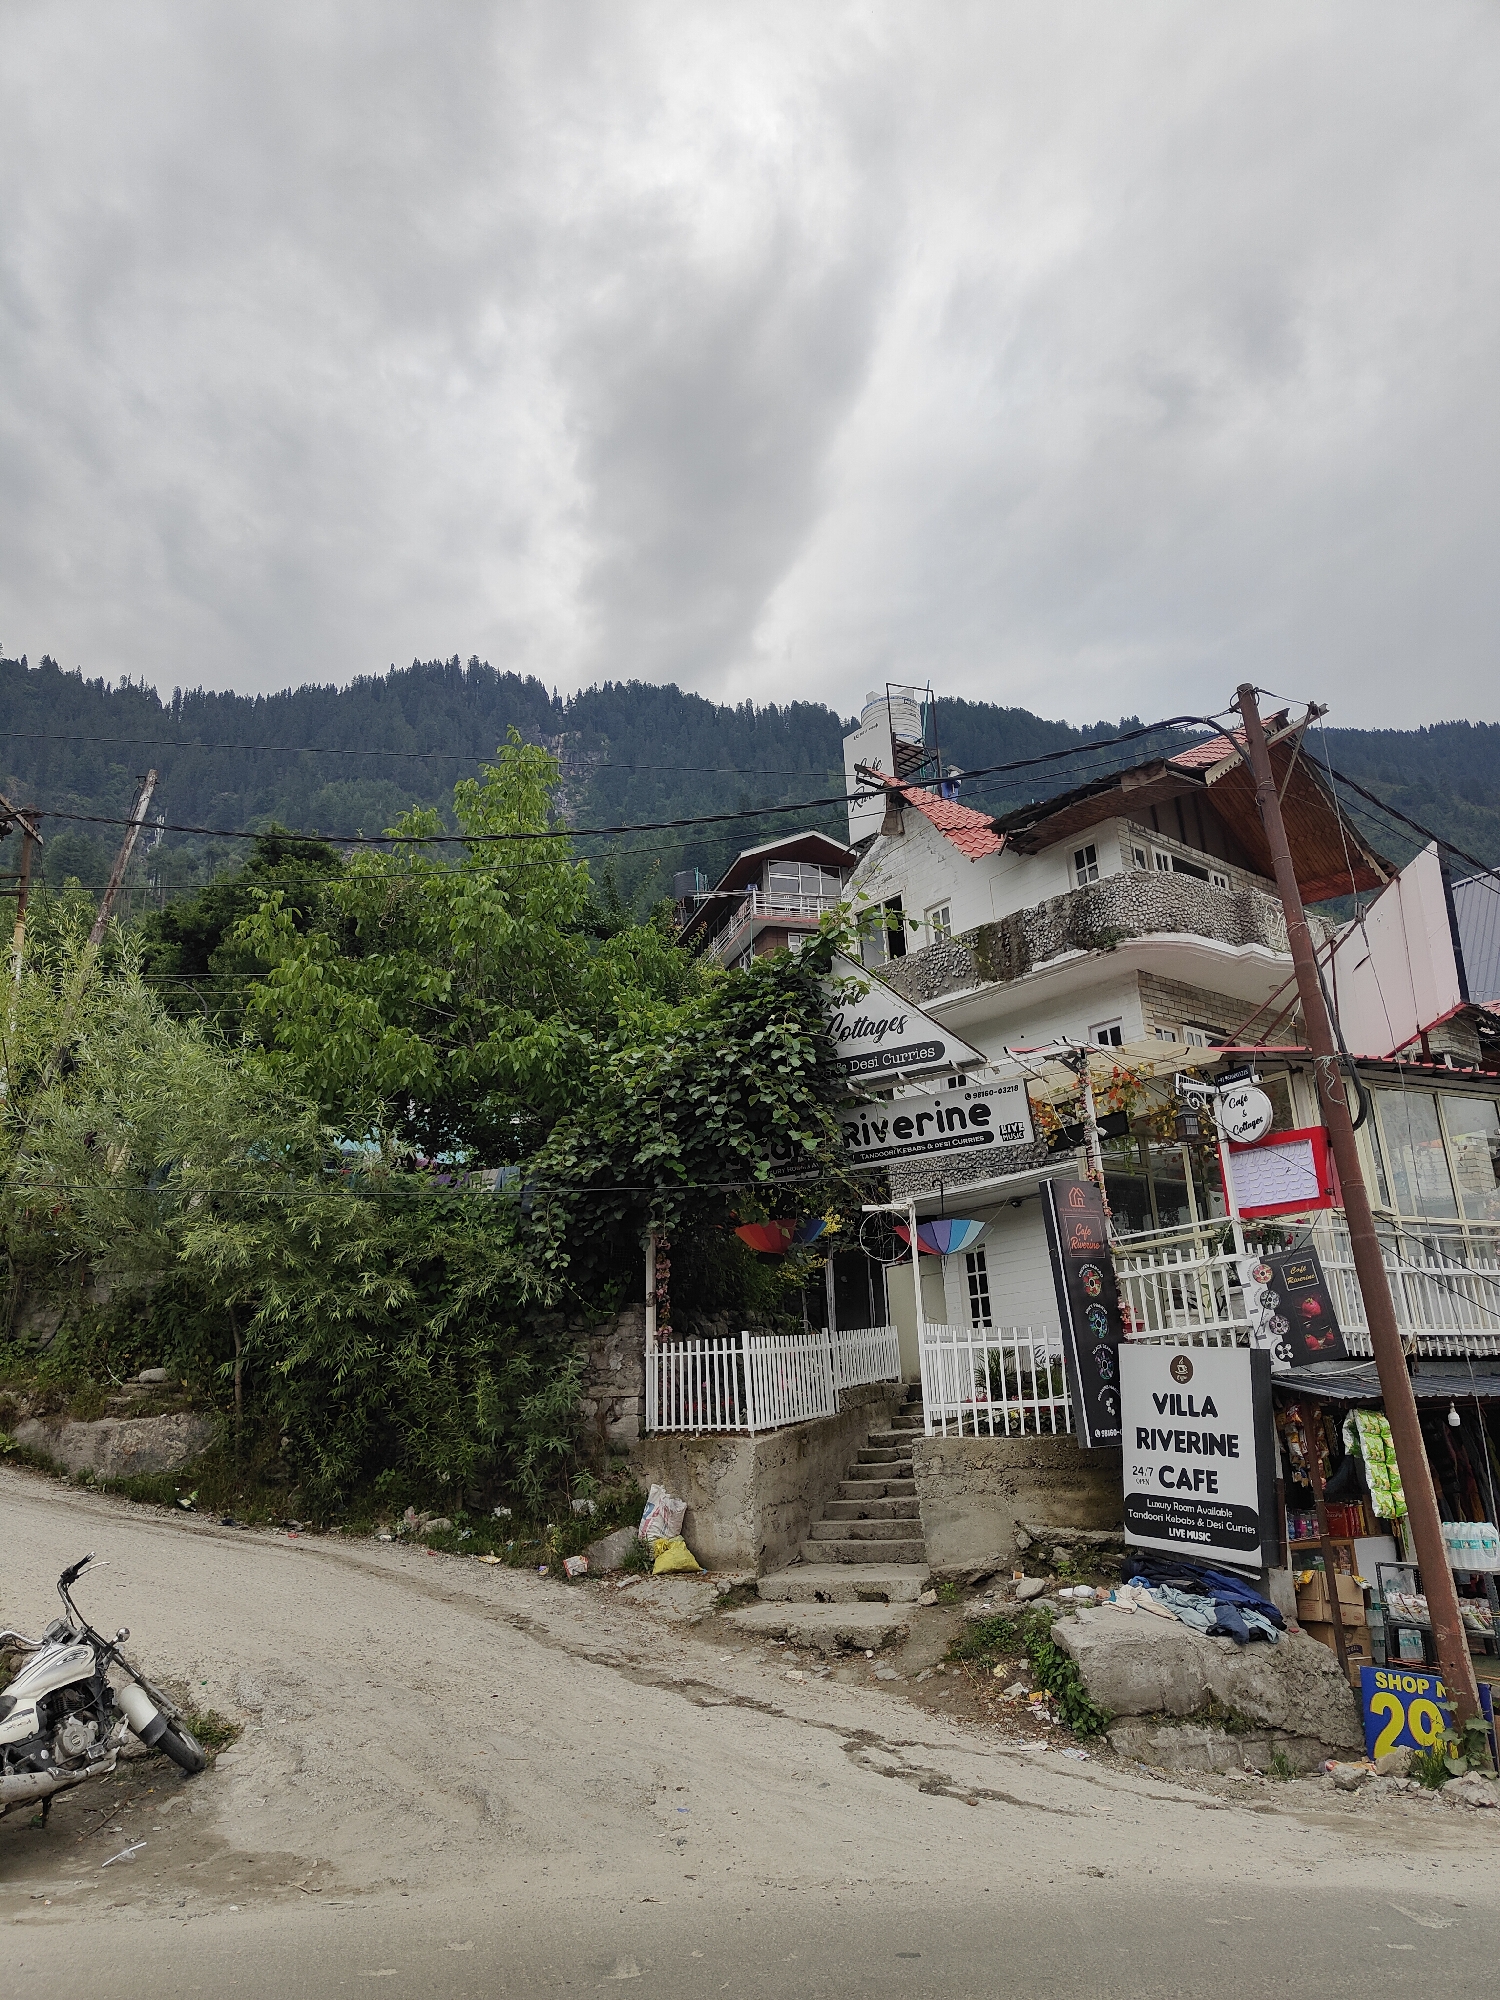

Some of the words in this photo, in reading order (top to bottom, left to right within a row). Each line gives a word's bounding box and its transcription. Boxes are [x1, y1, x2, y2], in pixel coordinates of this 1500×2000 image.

[823, 1013, 908, 1047] Cottages
[850, 1056, 878, 1071] Desi
[882, 1047, 935, 1066] Curries
[973, 1085, 1018, 1099] 98160-03218
[842, 1101, 991, 1148] Riverine
[1000, 1122, 1025, 1134] LIVE
[1002, 1132, 1024, 1141] MUSIC
[860, 1149, 896, 1160] TANDOORI
[896, 1145, 926, 1154] KEBABS
[934, 1140, 951, 1148] DESI
[952, 1136, 985, 1146] CURRIES
[1070, 1236, 1101, 1249] Riverine
[1152, 1392, 1219, 1418] VILLA
[1136, 1426, 1240, 1458] RIVERINE
[1132, 1465, 1154, 1477] 24/7
[1158, 1465, 1219, 1494] CAFE
[1146, 1499, 1172, 1511] Luxury
[1173, 1501, 1195, 1513] Room
[1196, 1505, 1233, 1518] Available
[1127, 1508, 1164, 1521] Tandoori
[1165, 1513, 1195, 1526] Kebabs
[1197, 1518, 1204, 1527] &
[1206, 1519, 1224, 1530] Desi
[1226, 1522, 1256, 1535] Curries
[1168, 1527, 1185, 1537] LIVE
[1186, 1530, 1211, 1542] MUSIC
[1375, 1672, 1429, 1695] SHOP
